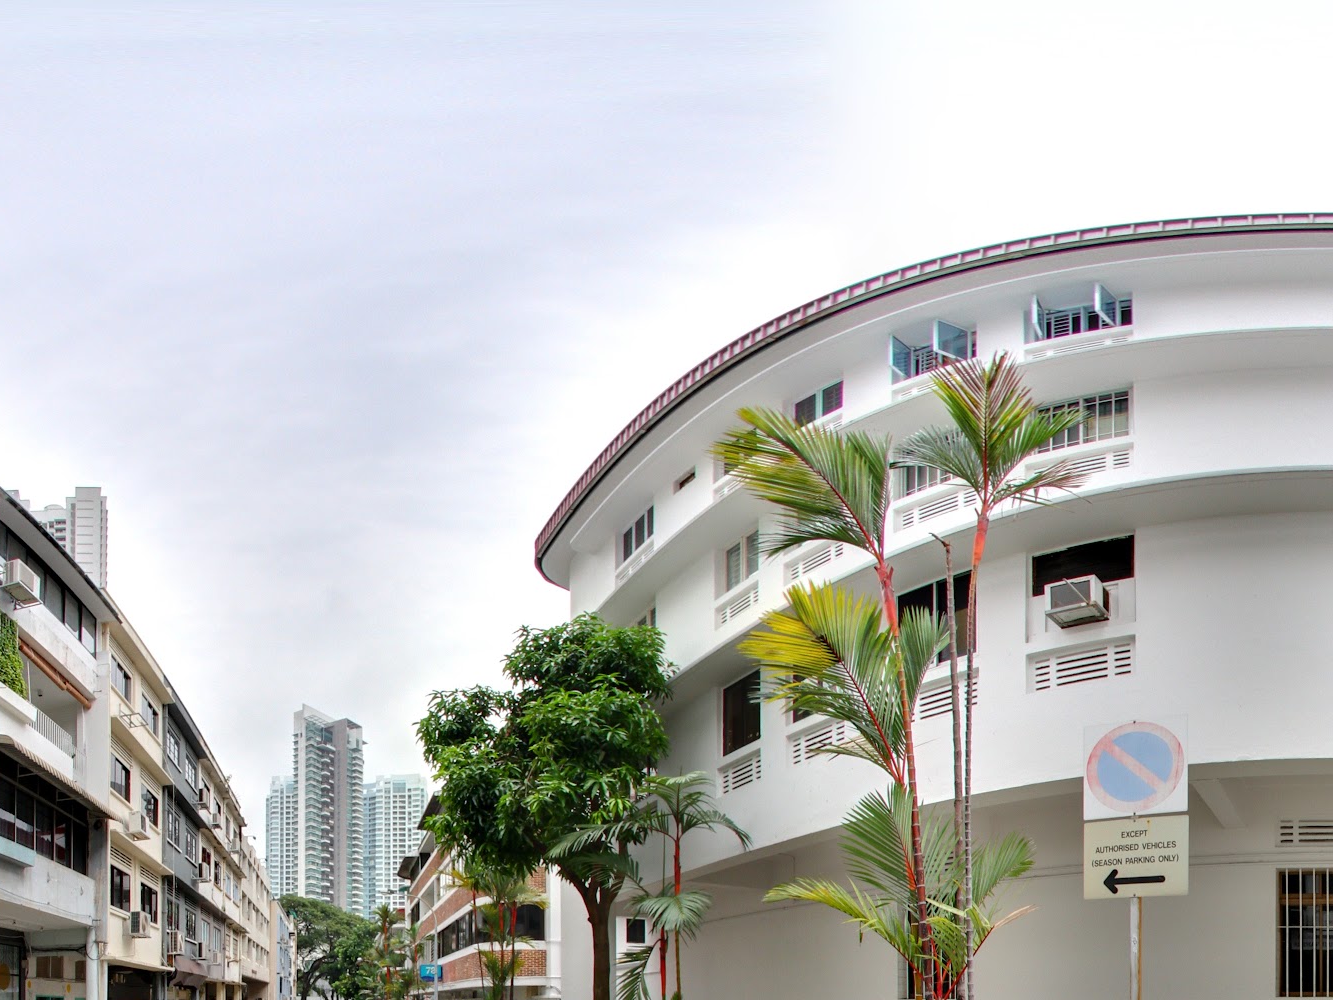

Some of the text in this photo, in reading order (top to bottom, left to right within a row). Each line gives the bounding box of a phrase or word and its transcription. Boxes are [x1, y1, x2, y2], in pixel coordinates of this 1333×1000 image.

[1121, 830, 1148, 838] EXCEPT
[1095, 841, 1177, 854] AUTHORISED VEHICLES
[1091, 854, 1179, 867] (SEASON PARKING ONLY)
